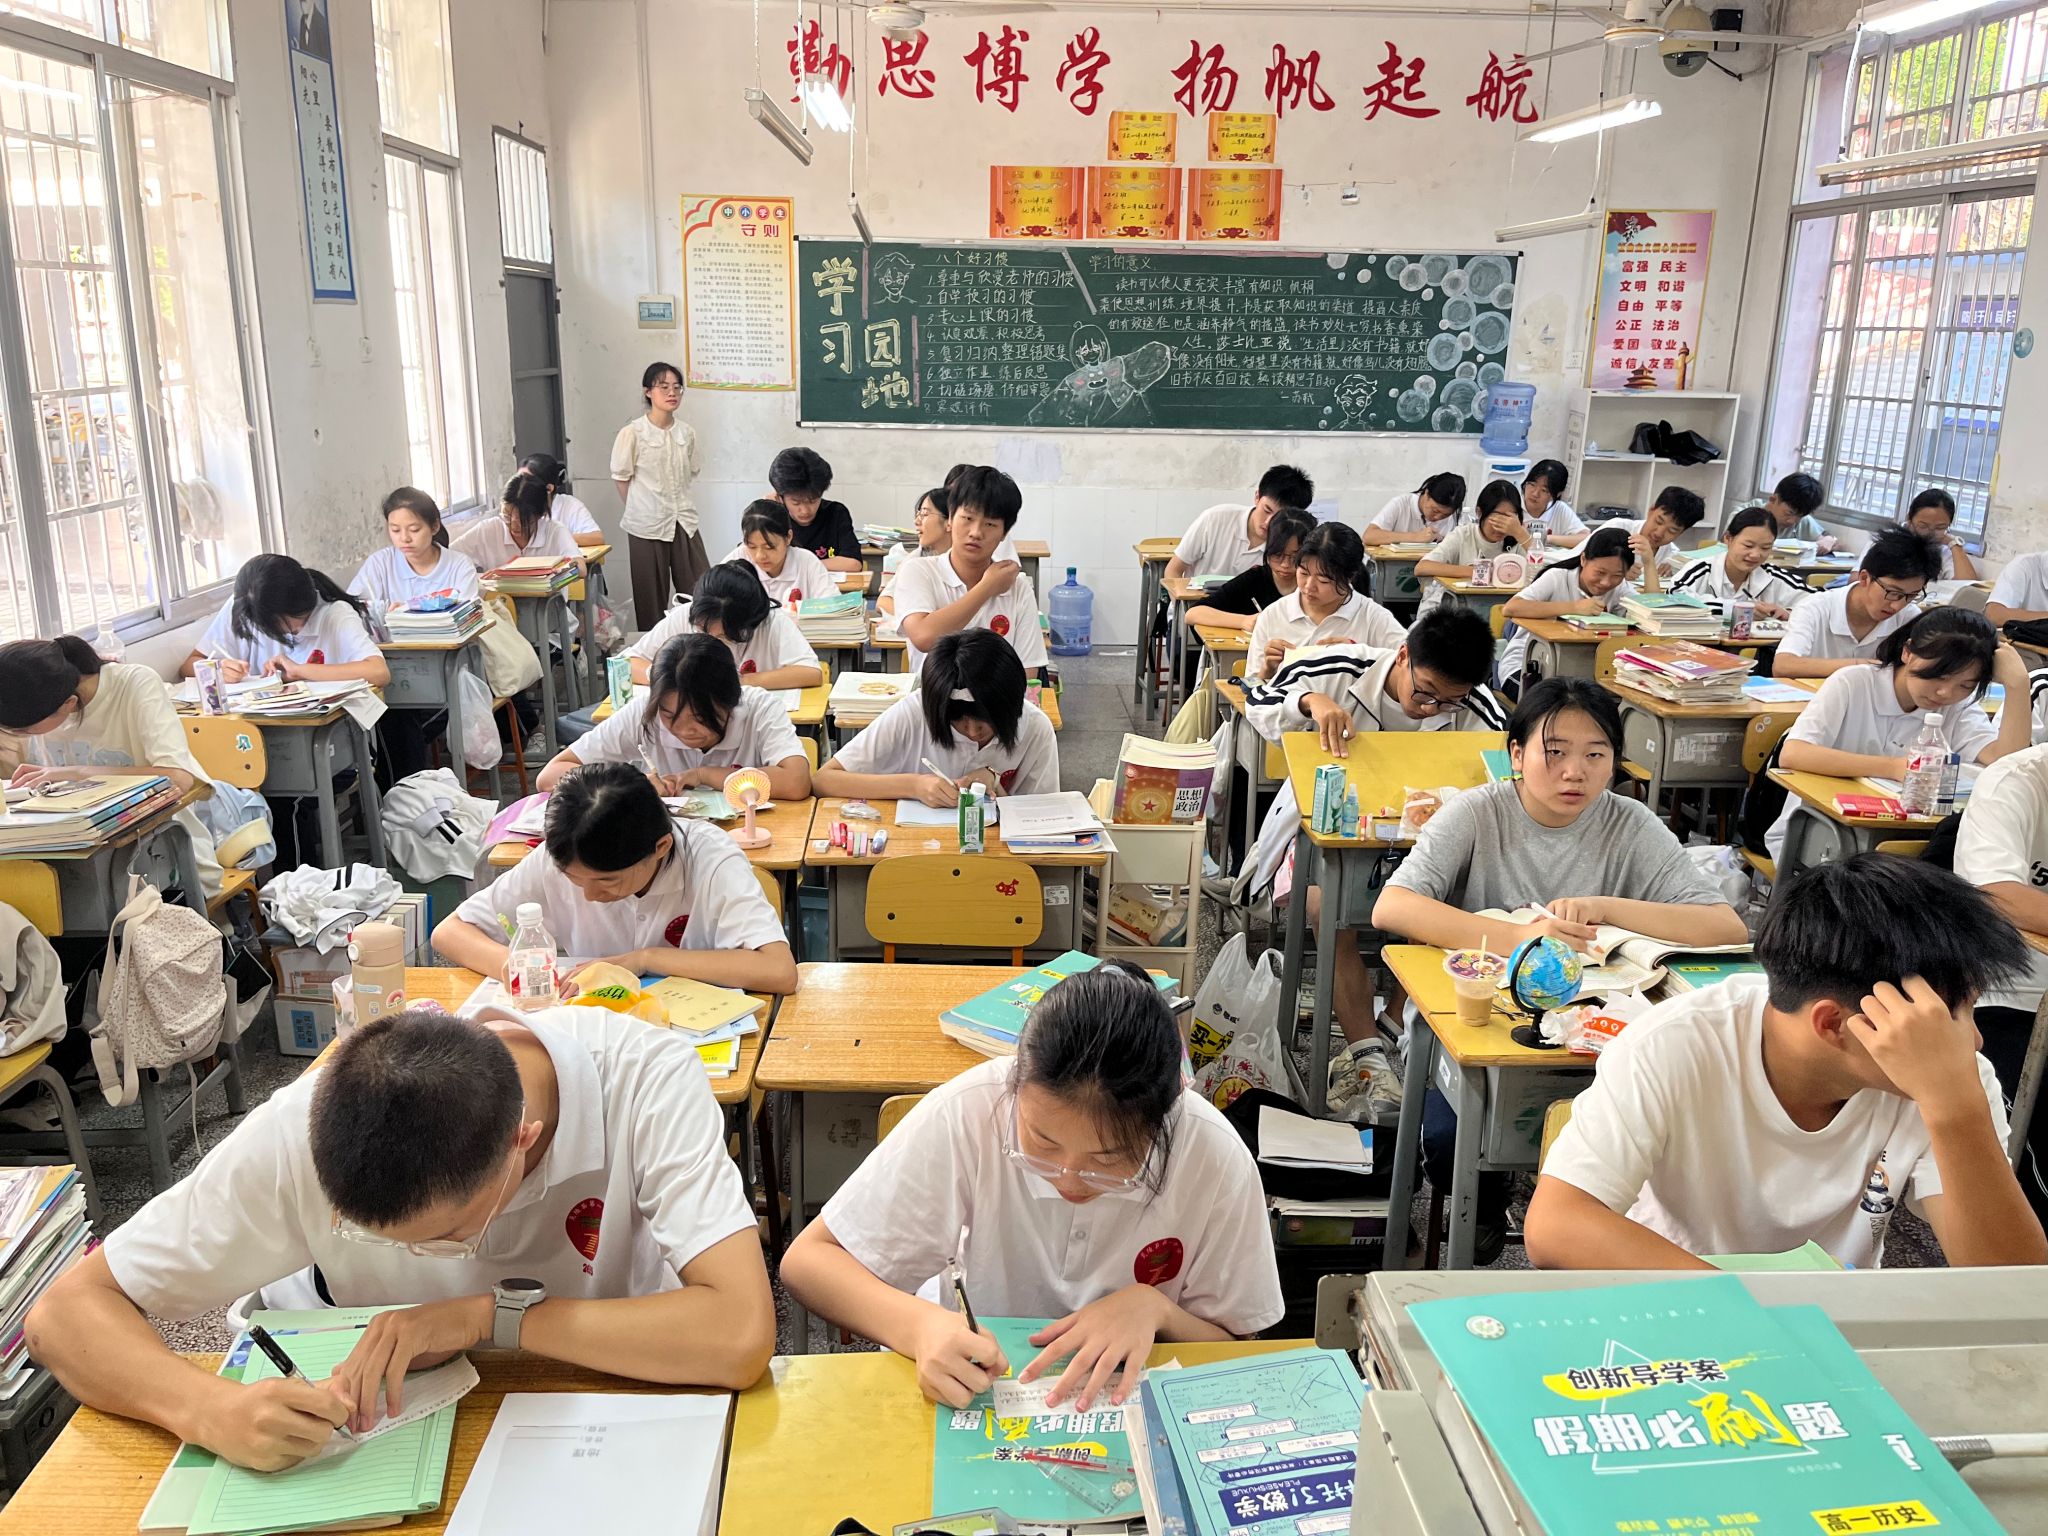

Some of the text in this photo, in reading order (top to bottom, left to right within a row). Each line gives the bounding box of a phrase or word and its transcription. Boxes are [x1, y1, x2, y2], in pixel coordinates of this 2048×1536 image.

[1172, 41, 1539, 123] 扬帆起航
[722, 205, 787, 222] 中小学生
[741, 223, 780, 238] 守则
[936, 250, 1009, 267] 八个好习惯
[1622, 260, 1688, 273] 富强 民主
[1619, 280, 1686, 293] 文明 和谐
[1617, 300, 1683, 312] 自由 平等
[812, 256, 858, 374] 学习
[1615, 319, 1680, 332] 公正 法治
[1613, 338, 1678, 351] 爱国 敬业
[862, 318, 914, 409] 园地
[1610, 357, 1676, 370] 诚信 友善
[1176, 789, 1203, 801] 思想
[1174, 800, 1200, 813] 政治
[1567, 1359, 1727, 1390] 创新导学案
[1531, 1388, 1851, 1457] 假期必刷题
[1818, 1504, 1926, 1532] 高一历史
